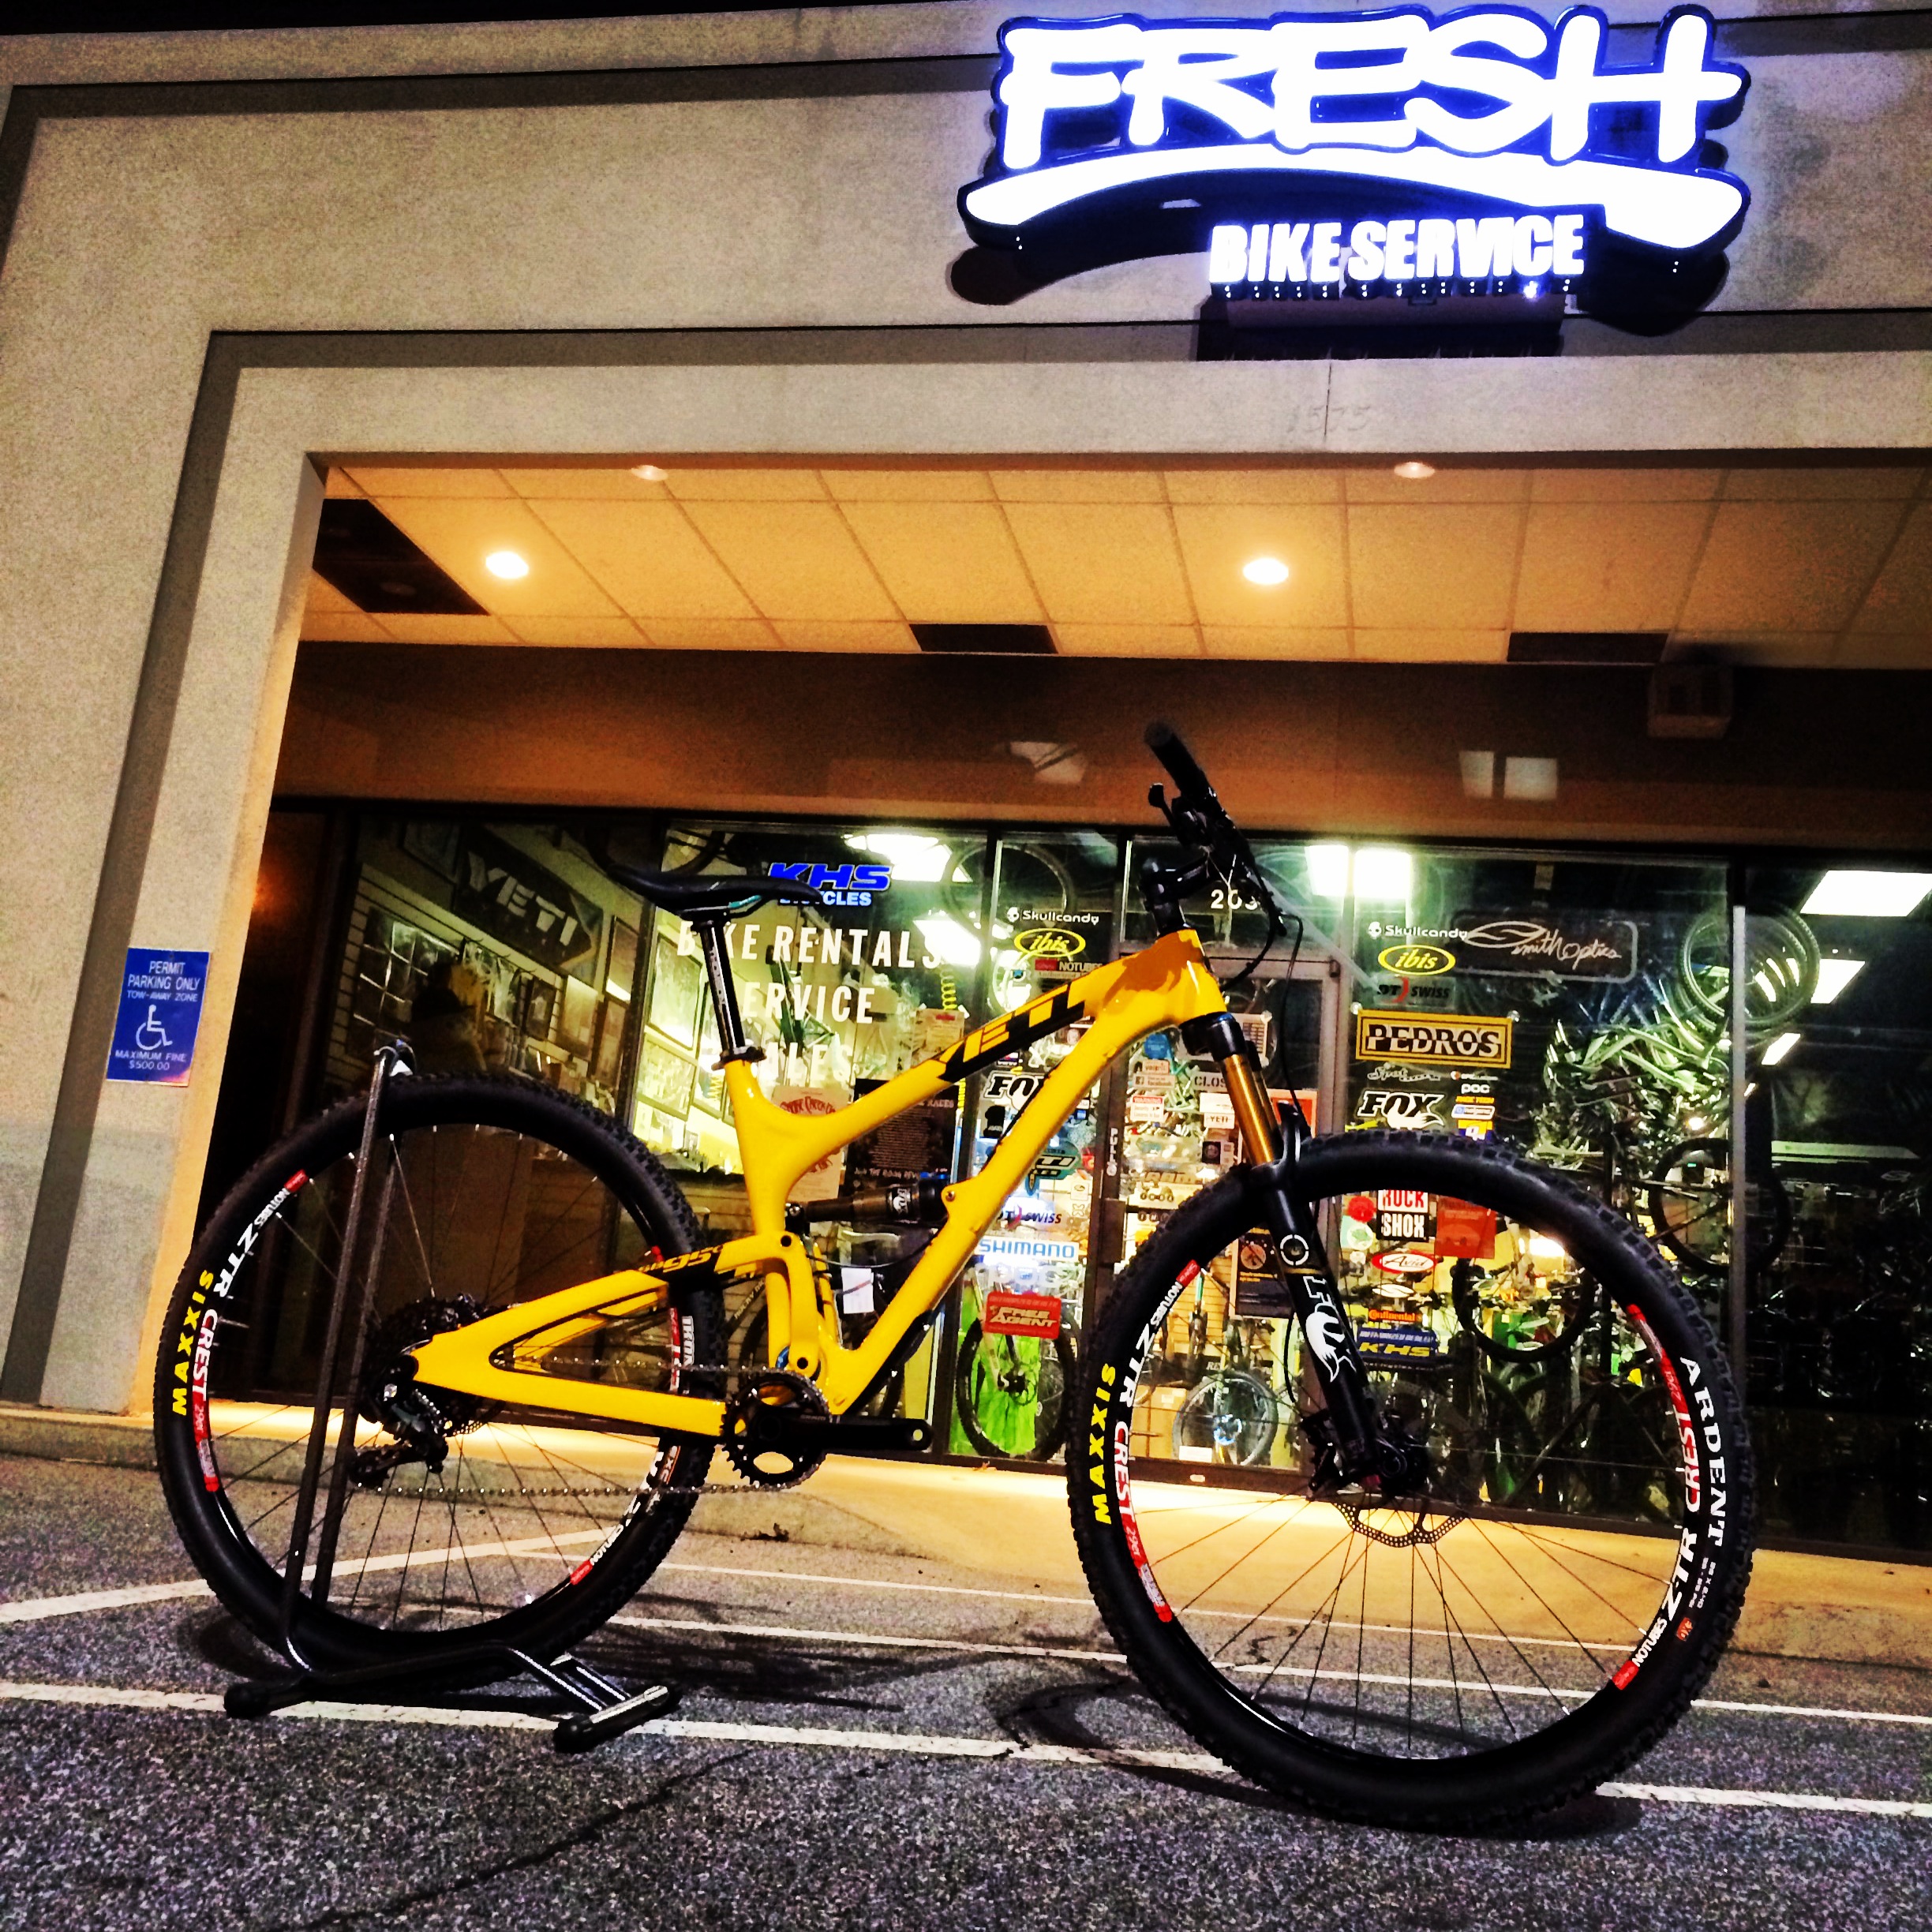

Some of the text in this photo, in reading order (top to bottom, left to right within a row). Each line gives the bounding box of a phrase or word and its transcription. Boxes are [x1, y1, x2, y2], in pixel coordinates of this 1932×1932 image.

[999, 11, 1744, 170] FRESH
[1209, 214, 1586, 285] BIKE SERVICE
[769, 863, 893, 891] KHS
[468, 851, 578, 946] YETI
[1022, 909, 1100, 925] Skullcandy
[676, 920, 943, 969] BKE RENTALS
[1029, 932, 1070, 953] ibis
[1385, 924, 1468, 941] Skullcandy
[148, 960, 186, 975] PERMIT
[1395, 949, 1439, 970] ibis
[127, 974, 201, 990] PARKING ONLY
[1410, 987, 1451, 999] SWISS
[126, 990, 199, 1002] TOW-AWAY ZONE
[743, 981, 875, 1024] ERVICE
[1367, 1024, 1501, 1058] PEDRO'S
[115, 1050, 187, 1062] MAXIMUM FINE
[984, 1074, 1046, 1099] FO
[1357, 1091, 1445, 1118] FOX
[1109, 1127, 1118, 1163] PULL
[1024, 1212, 1062, 1224] SWISS
[1382, 1213, 1425, 1238] SHOX
[979, 1239, 1076, 1259] SHIMANO
[1385, 1253, 1428, 1268] Avid
[1150, 1281, 1183, 1326] NOTUBES
[989, 1316, 1058, 1328] AGENT
[172, 1269, 214, 1417] MAXXIS
[193, 1309, 218, 1402] CREST
[1358, 1342, 1431, 1357] KHS
[1089, 1363, 1117, 1525] MAXXIS
[1680, 1356, 1727, 1547] ARDENT
[1114, 1420, 1136, 1522] CREST
[1672, 1403, 1701, 1514] CREST
[1631, 1617, 1669, 1668] NOTUBES
